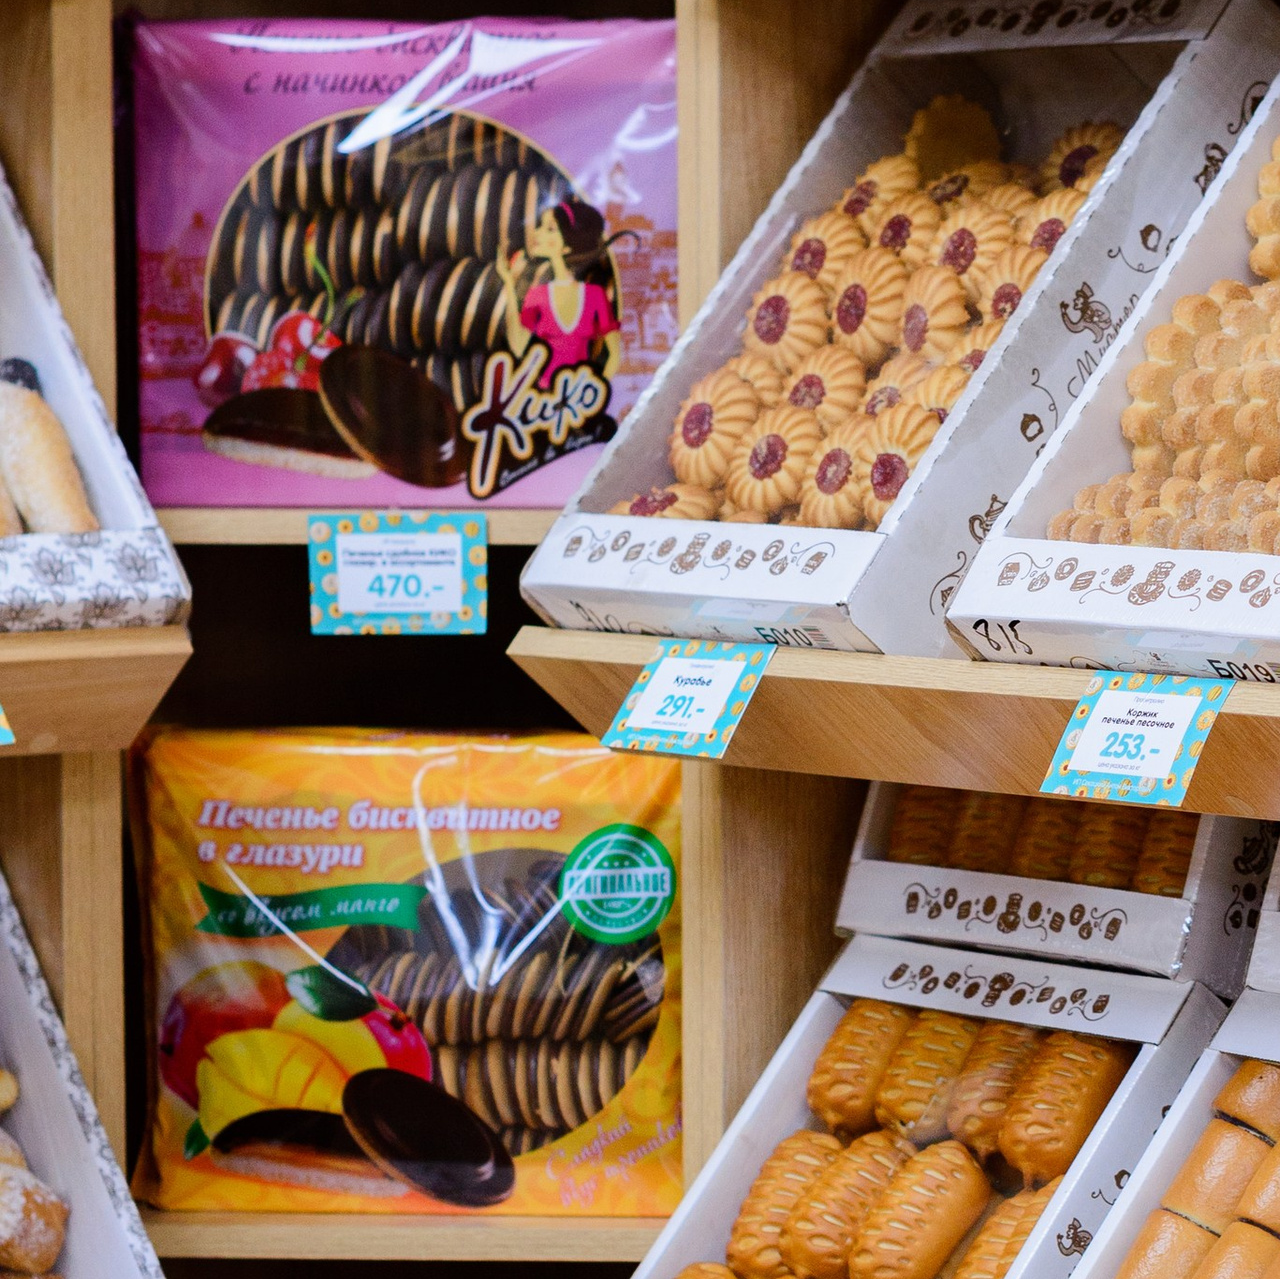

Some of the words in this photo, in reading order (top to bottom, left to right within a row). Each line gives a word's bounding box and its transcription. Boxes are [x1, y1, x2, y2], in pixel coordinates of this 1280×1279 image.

[273, 69, 412, 96] начинко
[1207, 659, 1276, 683] Б019
[1101, 716, 1135, 726] печенье
[1136, 719, 1175, 729] песочное
[1126, 708, 1158, 720] Коржик
[199, 800, 339, 831] Печенье
[199, 841, 217, 863] в
[225, 840, 365, 874] глазури
